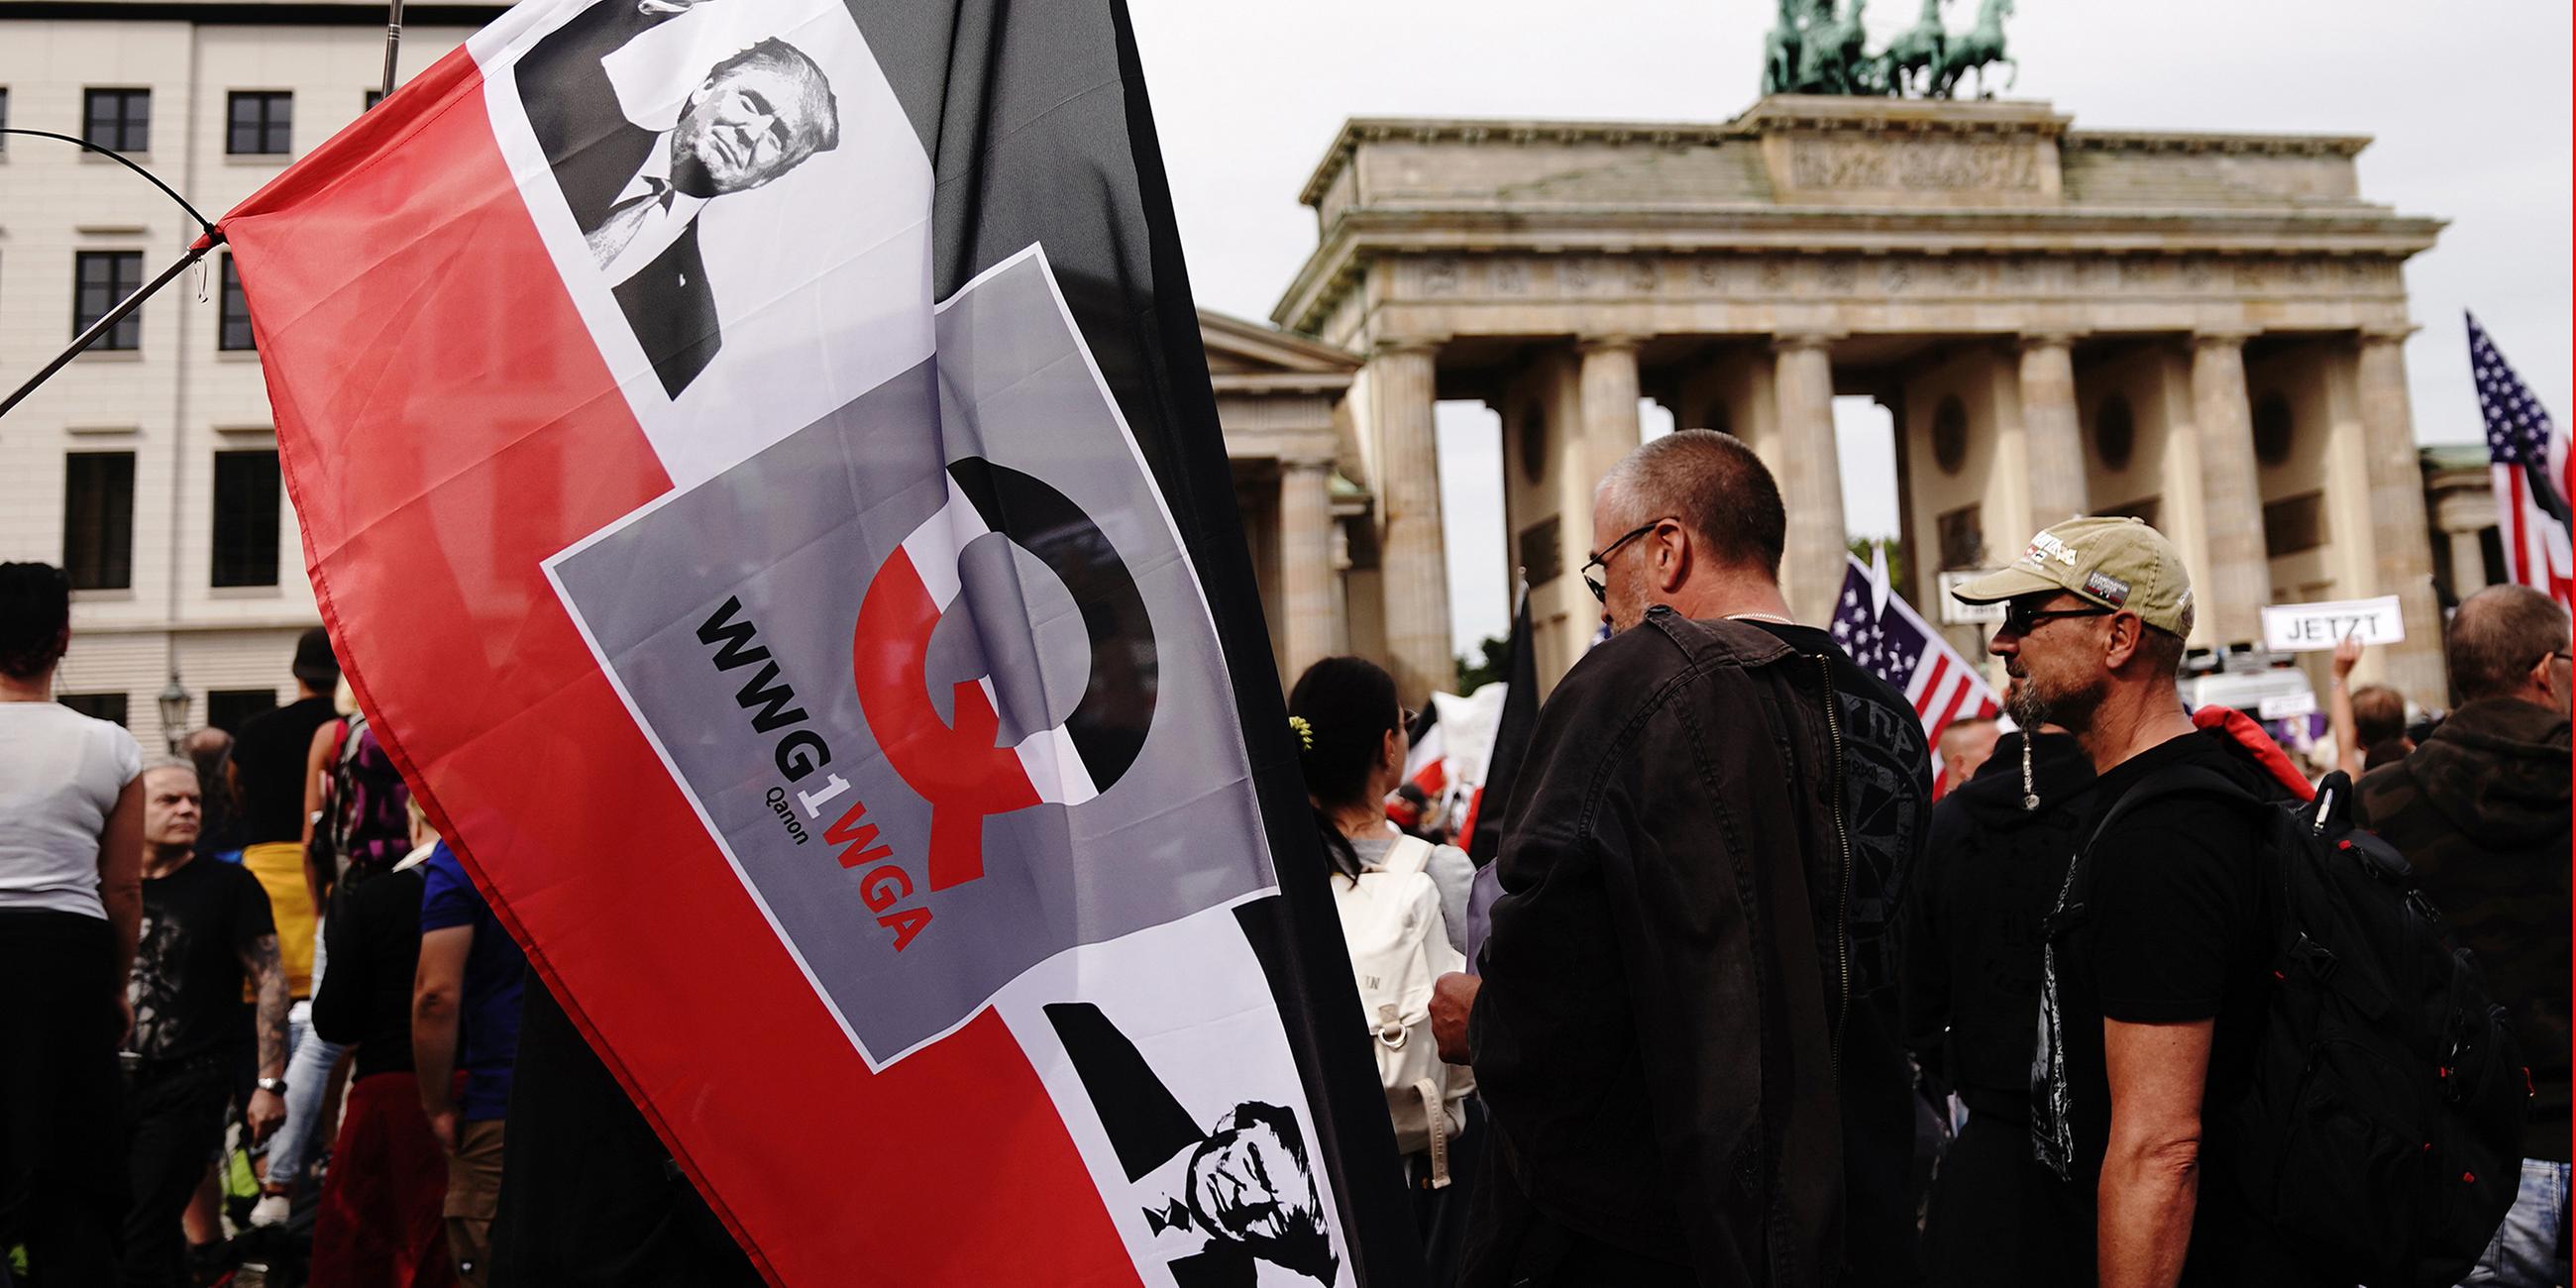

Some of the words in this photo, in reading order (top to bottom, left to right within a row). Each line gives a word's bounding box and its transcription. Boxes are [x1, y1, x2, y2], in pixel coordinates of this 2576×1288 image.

[2288, 612, 2380, 640] JETZT
[696, 594, 933, 953] WWG1WGA
[766, 786, 808, 846] Qanon
